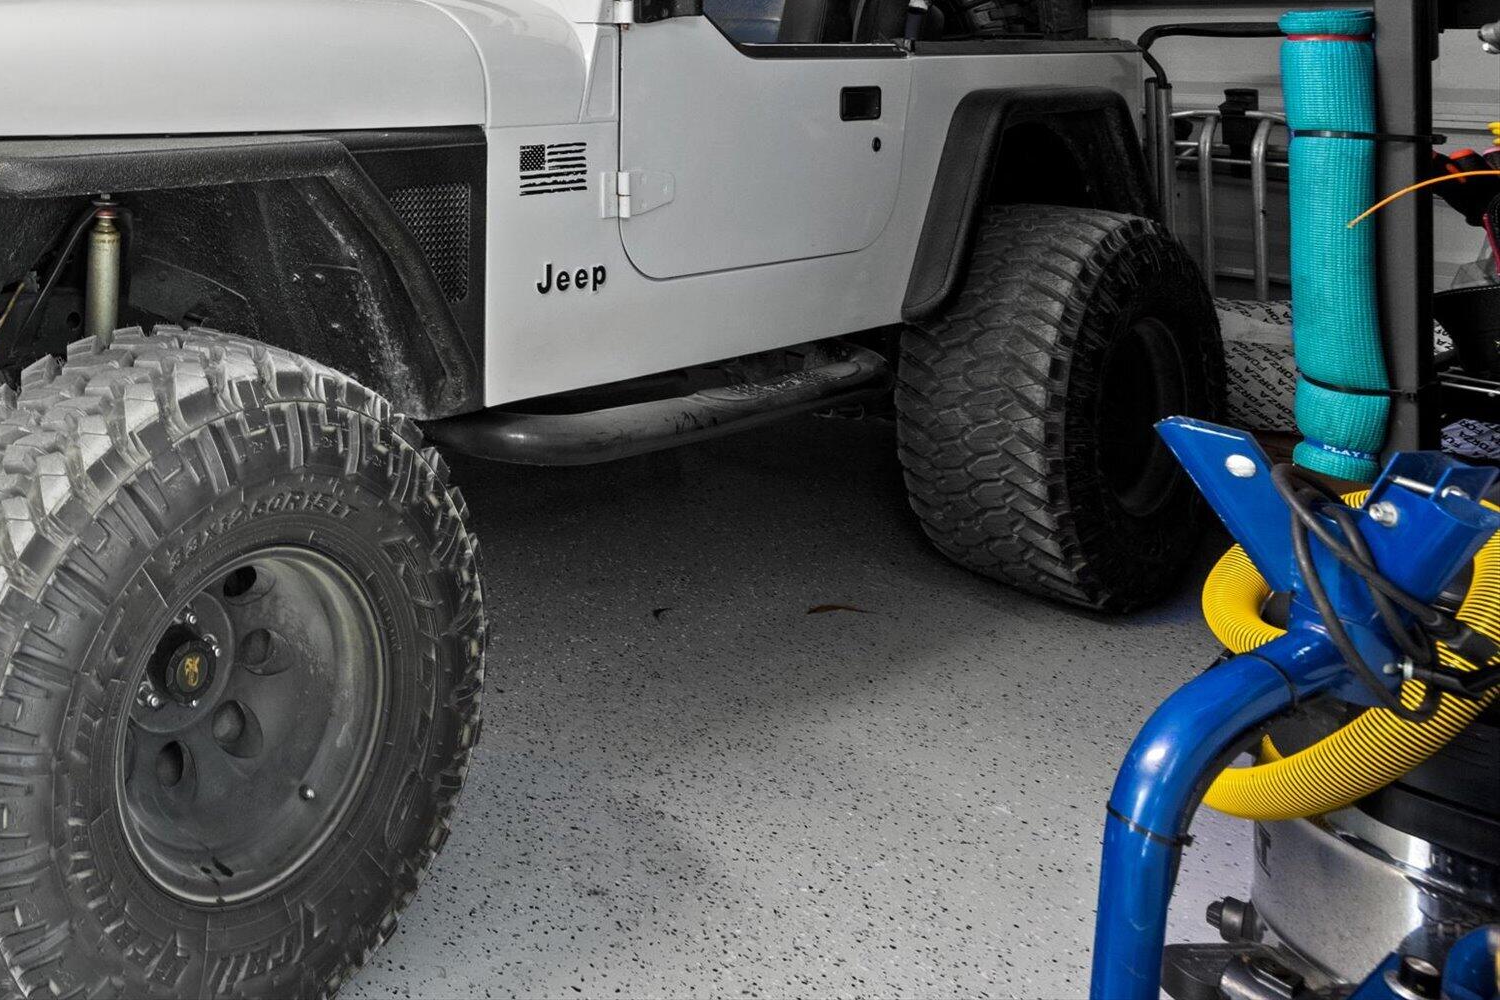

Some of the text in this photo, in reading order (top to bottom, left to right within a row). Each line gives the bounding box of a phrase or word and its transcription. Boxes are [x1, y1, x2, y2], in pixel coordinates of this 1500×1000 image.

[537, 263, 606, 294] Jeep
[1246, 366, 1283, 396] FORZA
[1323, 444, 1361, 458] PLAY
